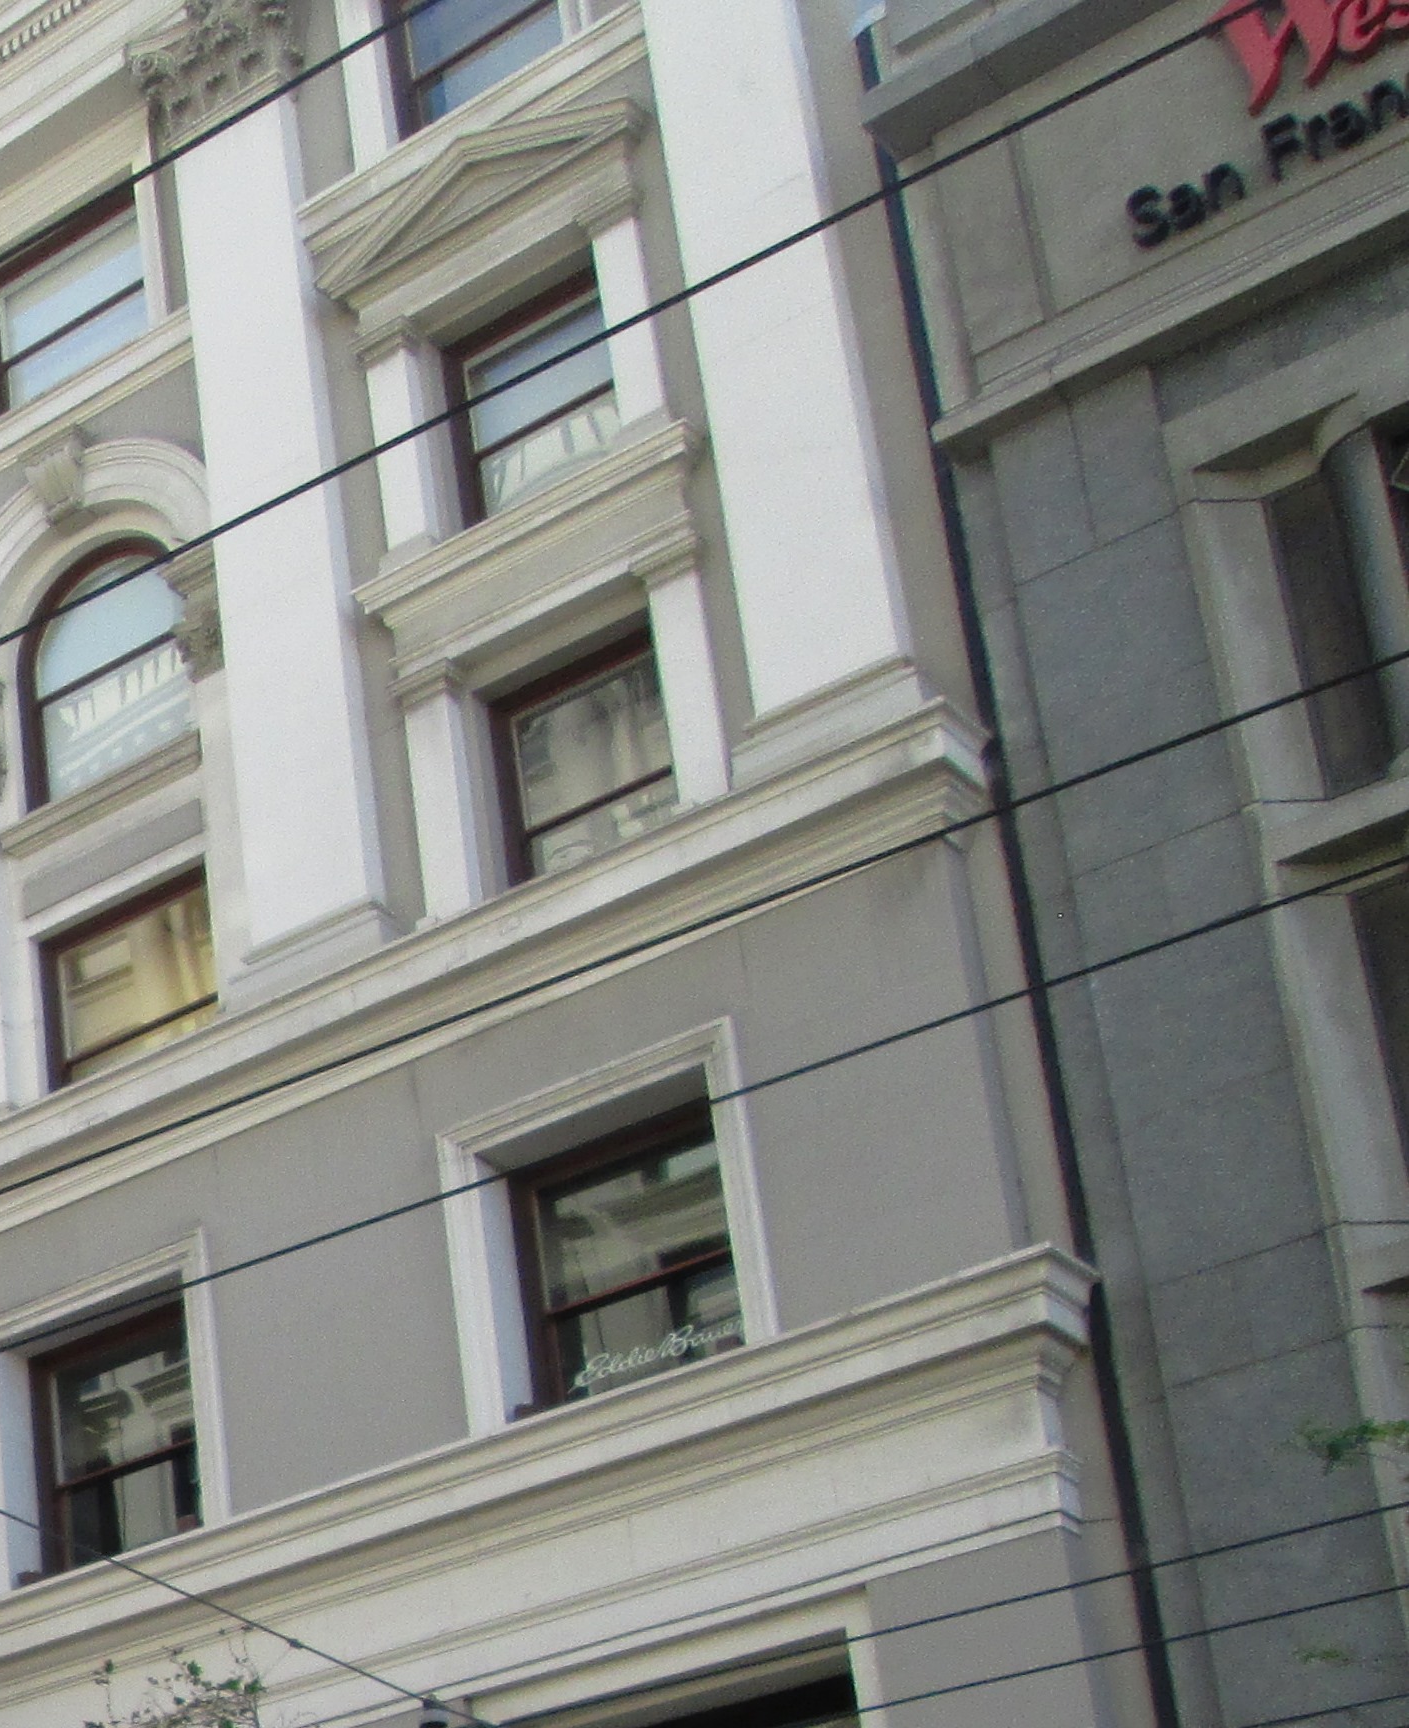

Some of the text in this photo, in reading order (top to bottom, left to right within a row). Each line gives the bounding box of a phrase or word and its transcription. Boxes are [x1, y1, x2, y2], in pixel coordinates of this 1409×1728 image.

[1208, 0, 1409, 117] We
[1126, 79, 1409, 249] San Fran
